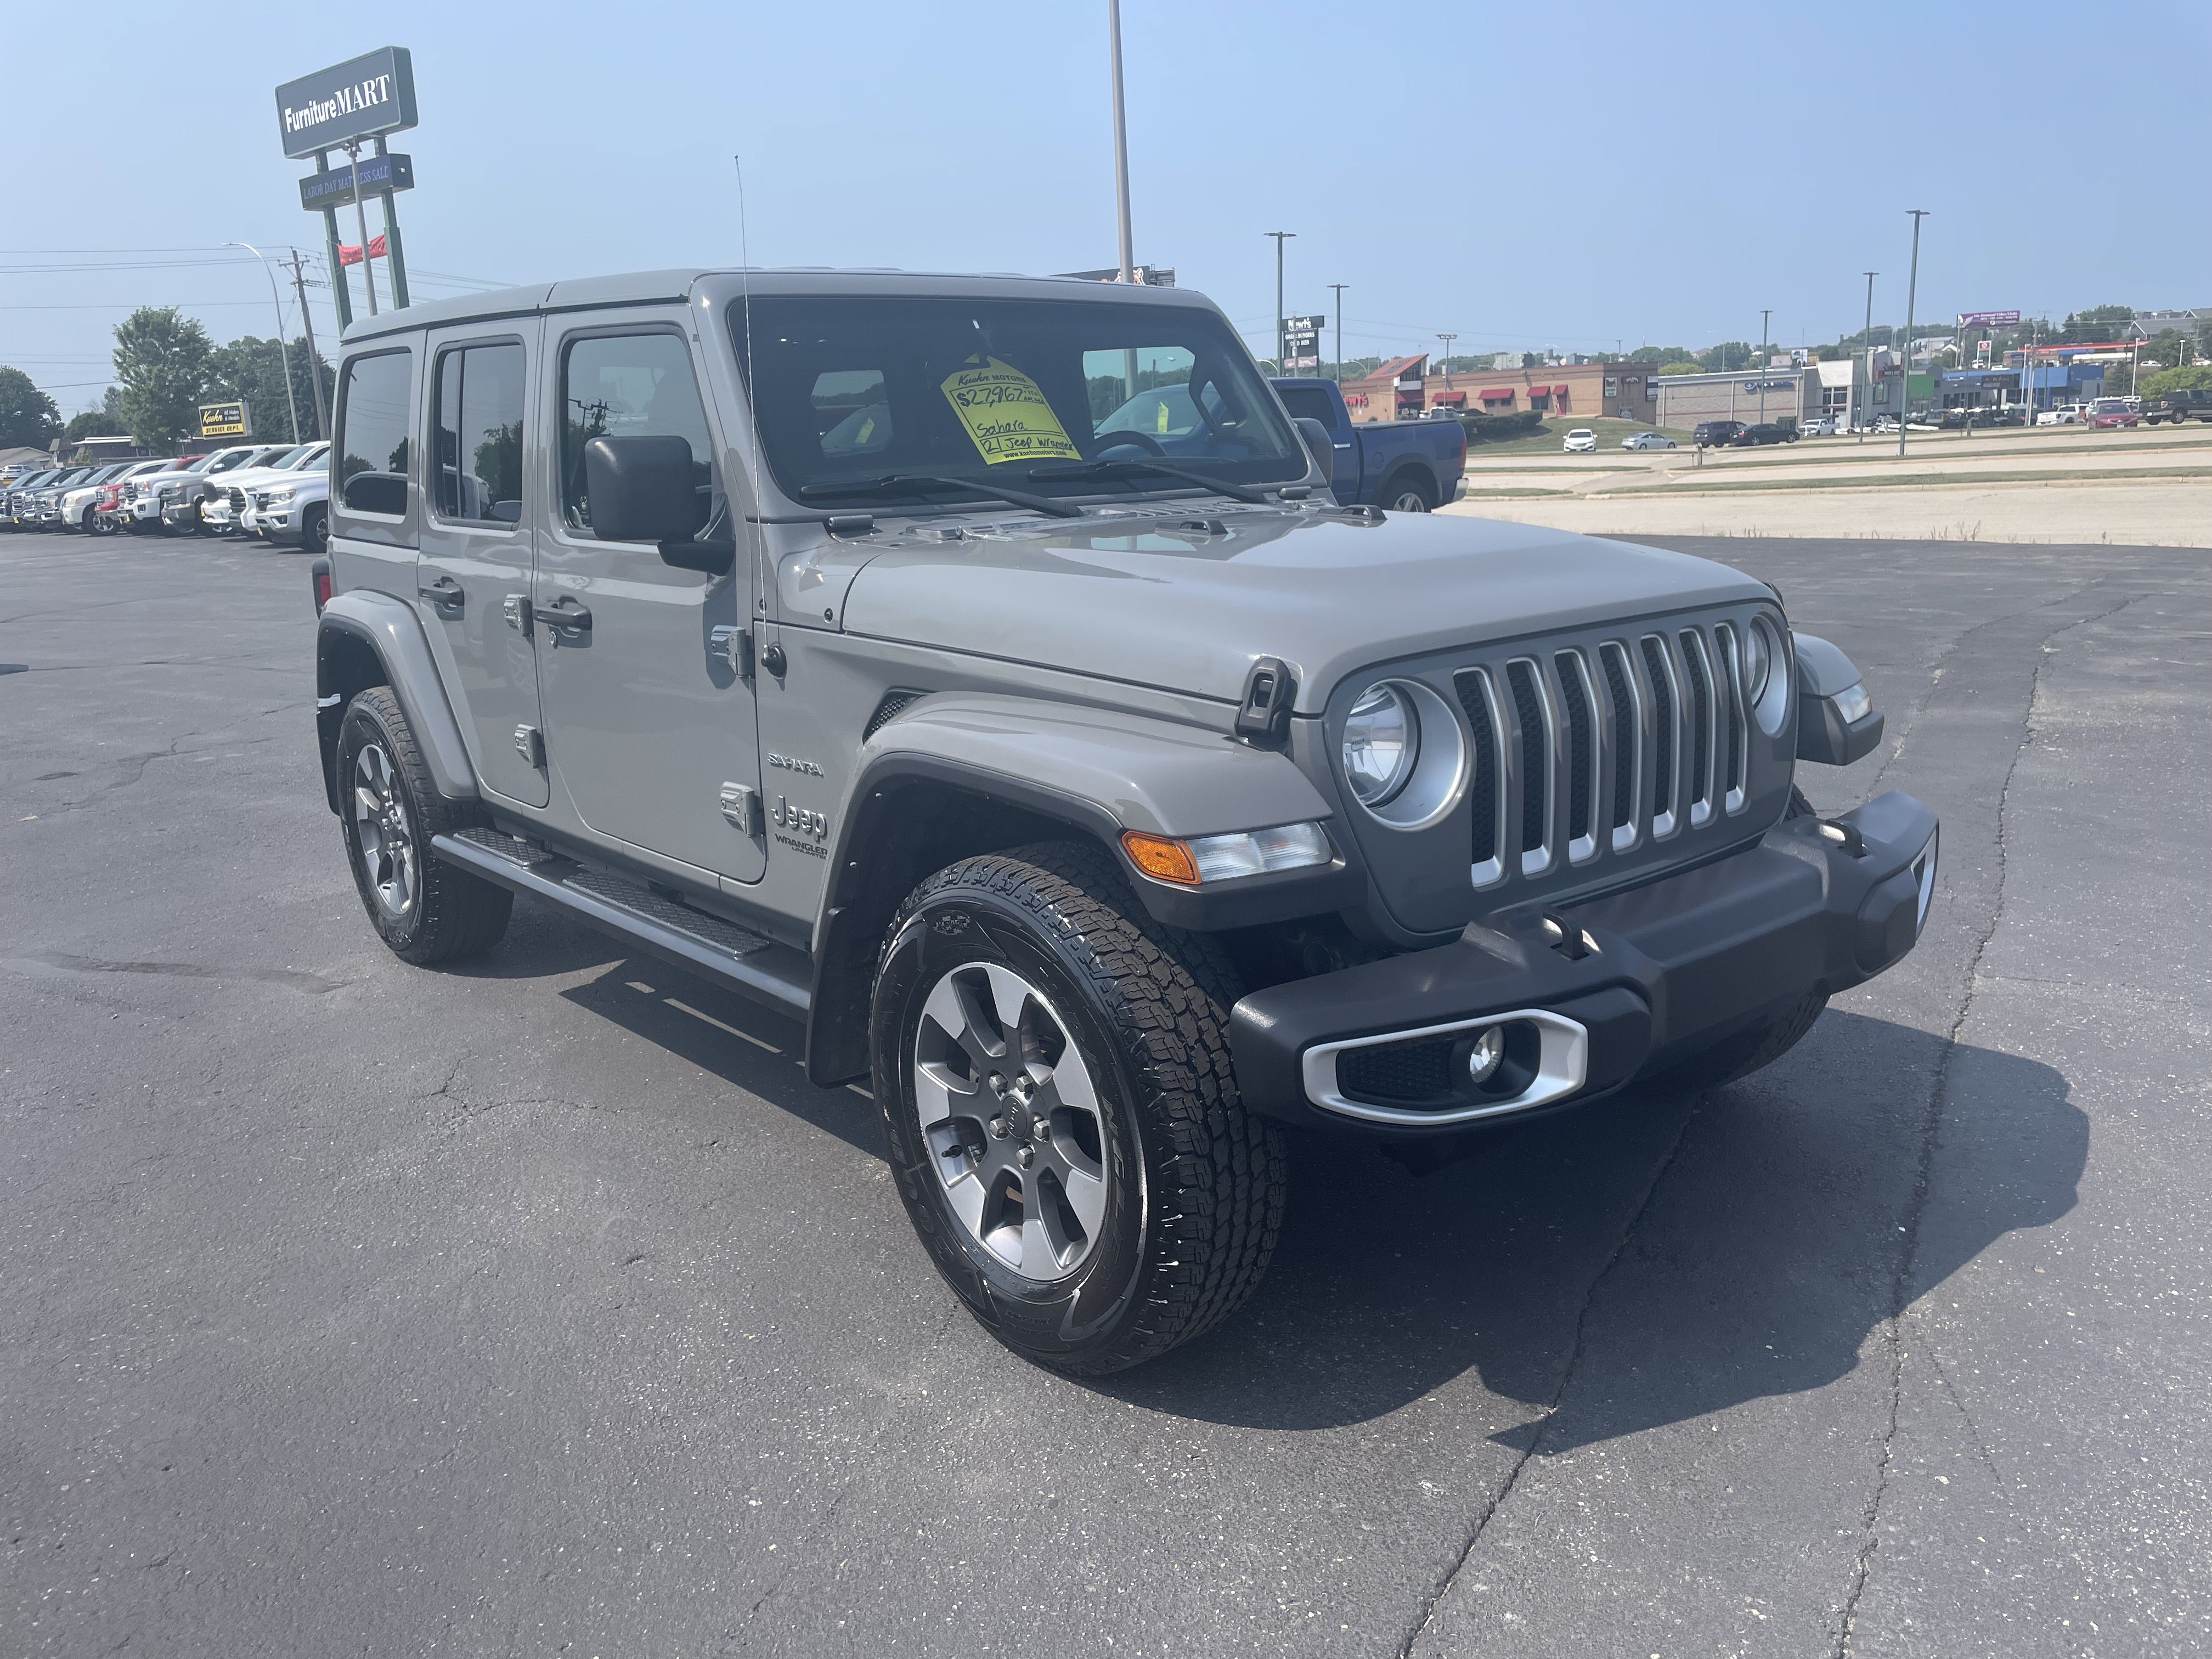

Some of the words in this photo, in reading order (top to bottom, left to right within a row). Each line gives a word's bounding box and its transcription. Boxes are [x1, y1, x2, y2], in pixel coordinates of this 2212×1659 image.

[285, 74, 390, 133] FurnitureMART
[303, 184, 323, 200] LABOR
[325, 180, 337, 194] DAY
[338, 171, 371, 190] MATESS
[372, 166, 388, 181] SALE
[958, 372, 990, 386] Kuehn
[991, 375, 1026, 383] MOTORS
[956, 386, 1023, 408] $27,967
[202, 409, 223, 424] Kuehn
[977, 419, 1028, 437] Sahara
[983, 438, 1003, 452] 21
[1006, 437, 1032, 449] Jeep
[1037, 437, 1074, 450] Wrangler
[767, 753, 824, 776] SAHARA
[770, 795, 827, 844] Jeep
[775, 833, 828, 856] WRANGLER
